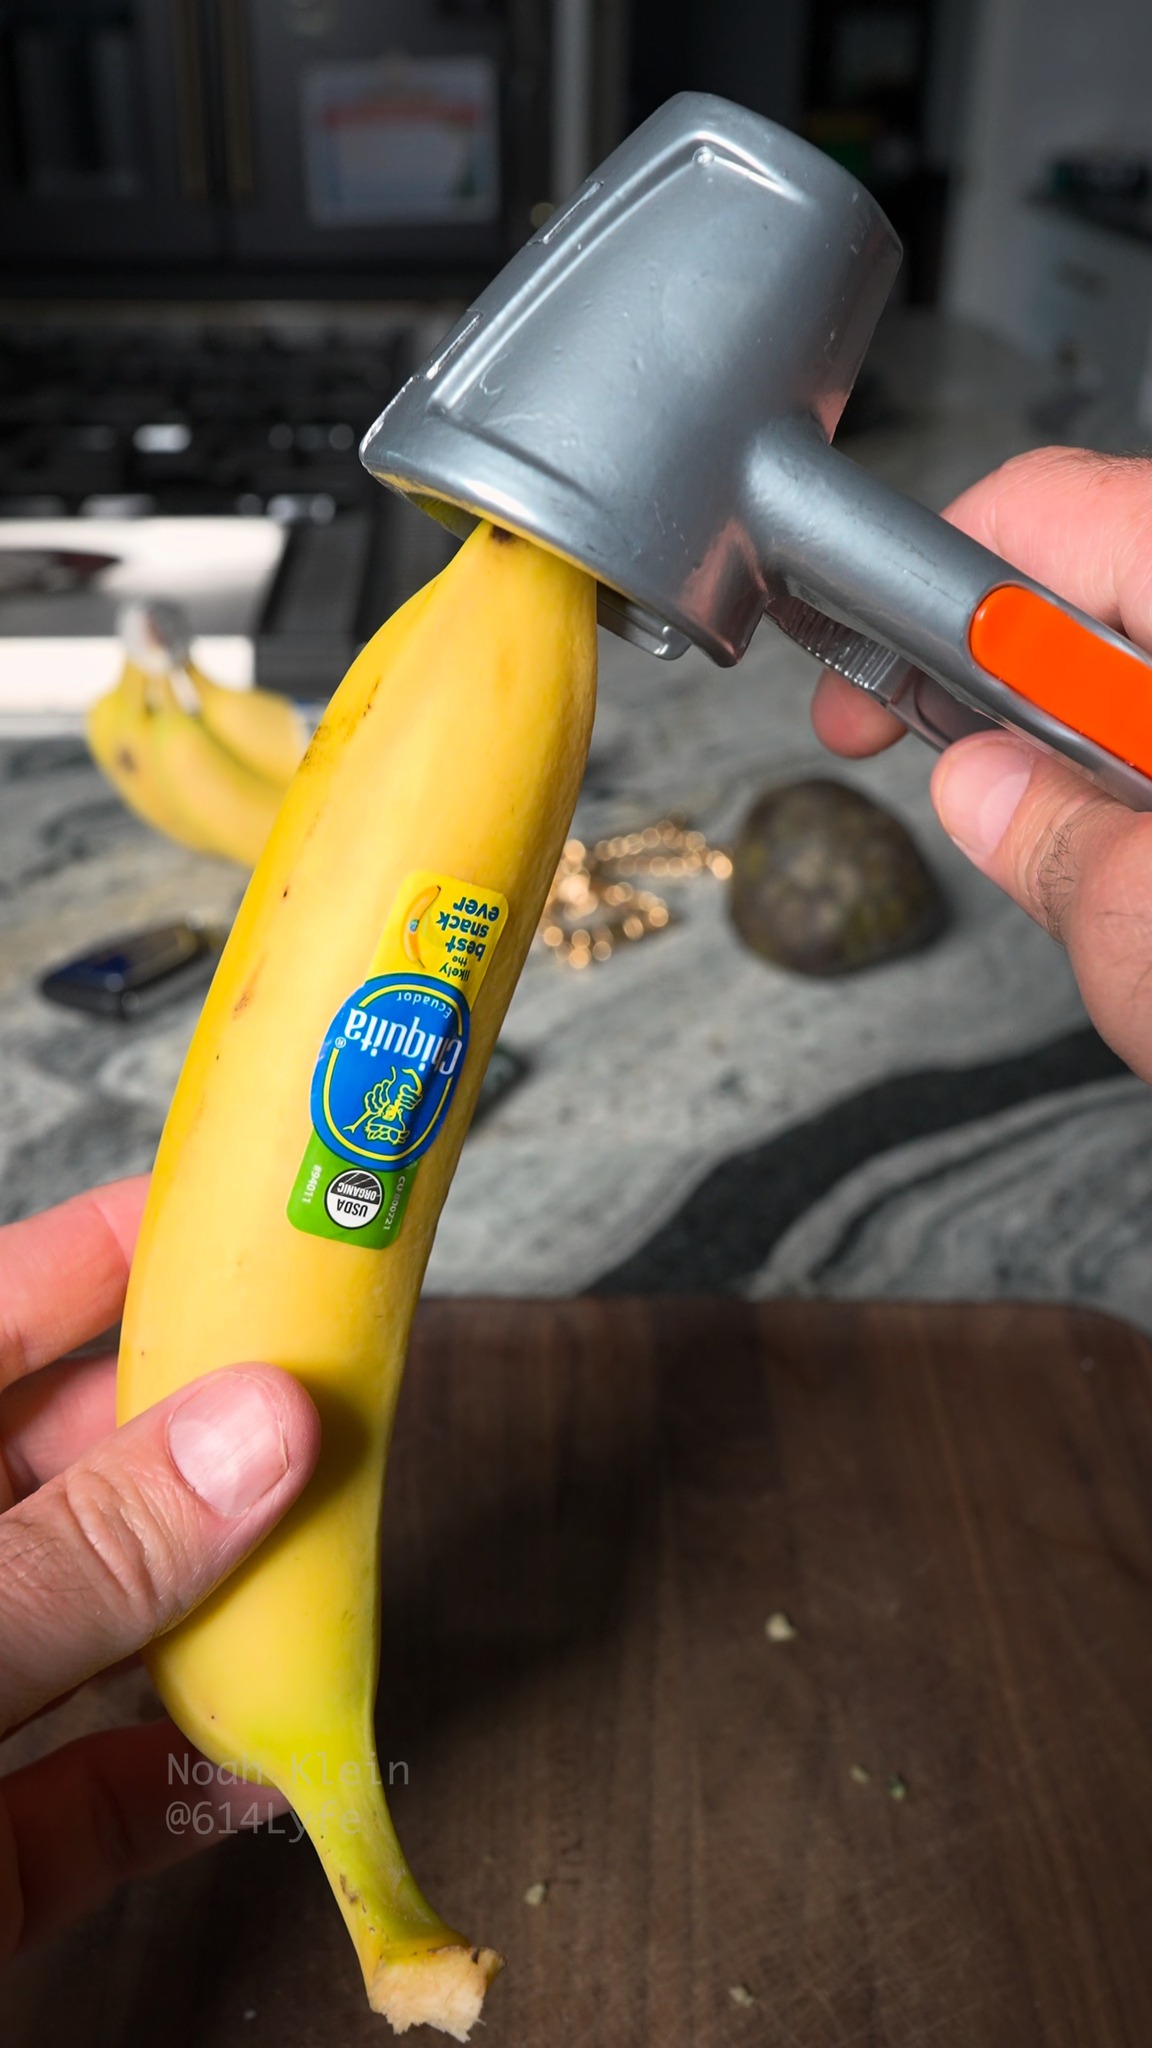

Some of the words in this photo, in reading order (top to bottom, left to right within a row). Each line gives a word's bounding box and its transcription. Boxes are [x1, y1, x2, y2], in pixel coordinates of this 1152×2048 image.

[453, 897, 499, 921] ever
[437, 911, 489, 937] snack
[446, 936, 486, 961] best
[439, 962, 470, 981] likely
[452, 956, 467, 966] the
[397, 992, 453, 1019] Ecuador
[337, 1182, 377, 1201] ORGANIC
[336, 1199, 368, 1217] USDA
